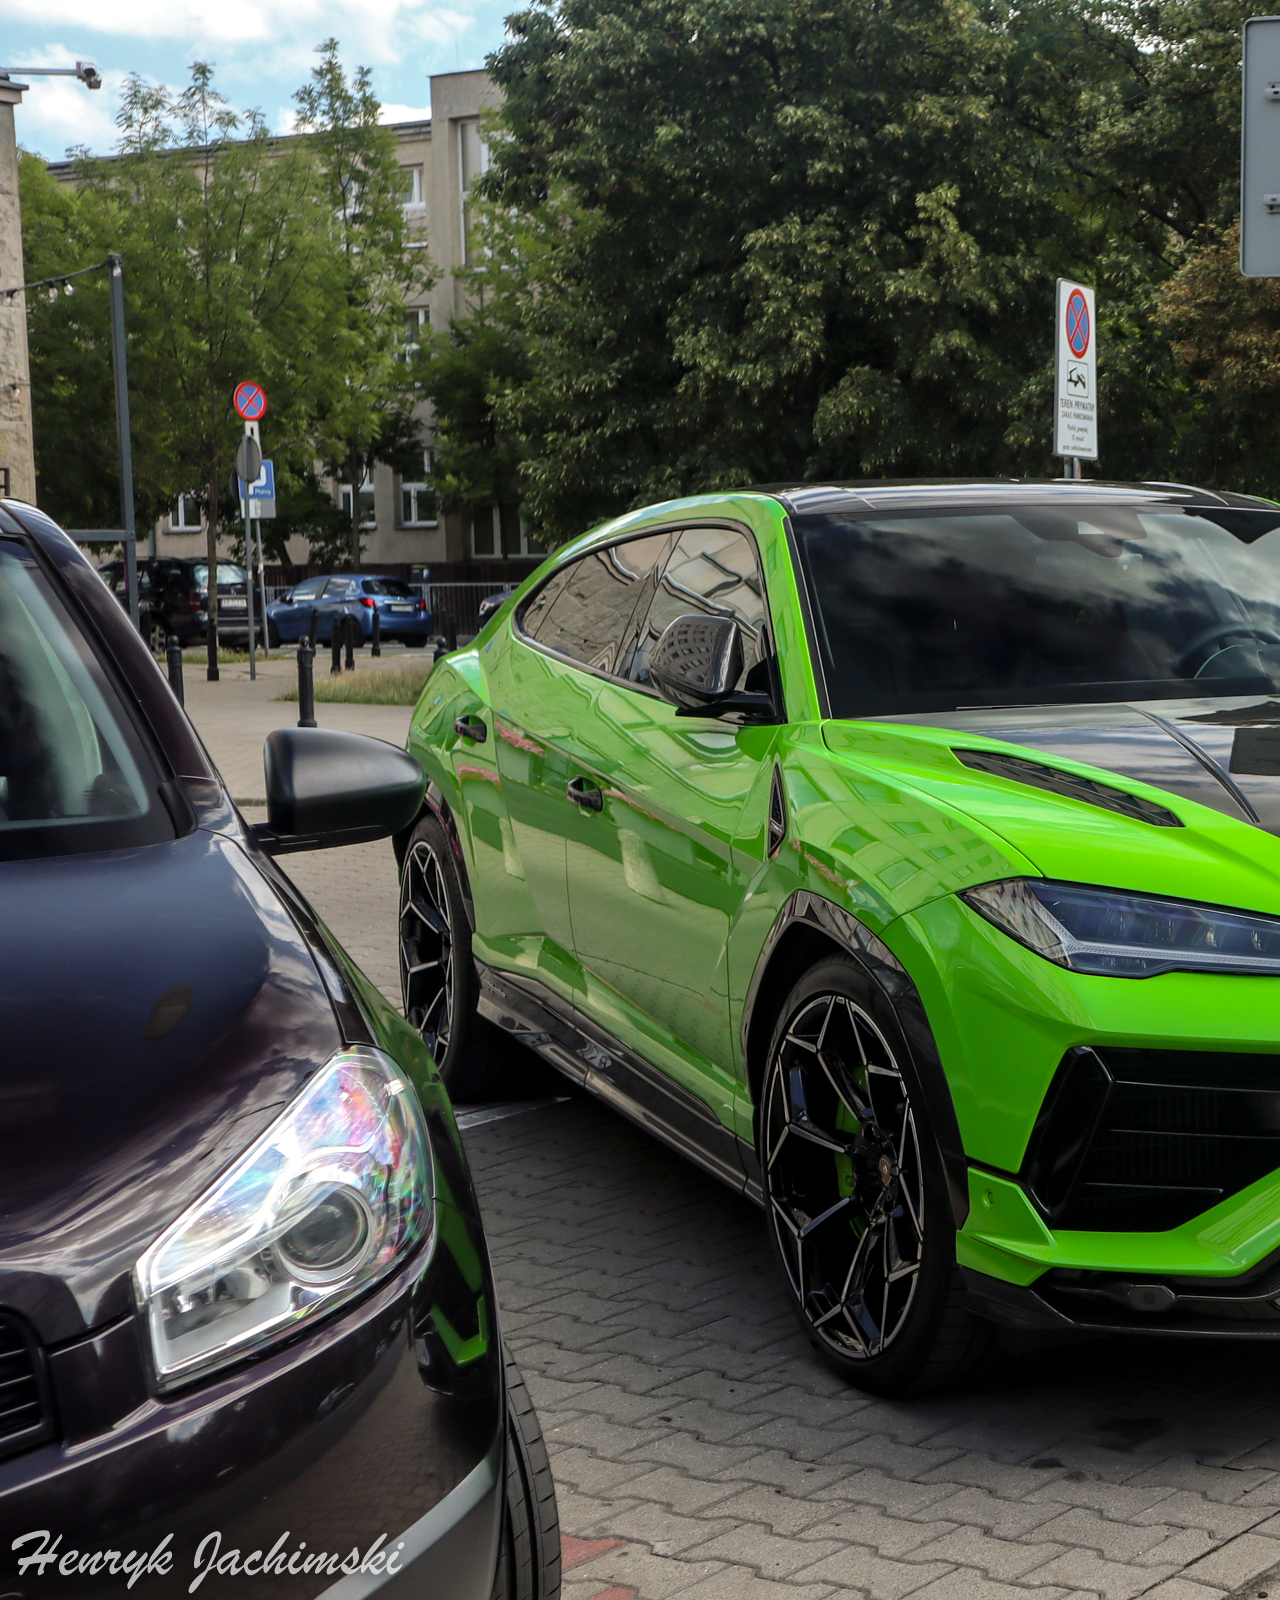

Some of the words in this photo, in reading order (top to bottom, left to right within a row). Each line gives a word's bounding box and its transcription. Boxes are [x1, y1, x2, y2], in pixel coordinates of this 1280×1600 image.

[1060, 398, 1073, 409] TEREN
[1074, 401, 1095, 412] PRYWATNY
[1061, 411, 1072, 419] ZAKAZ
